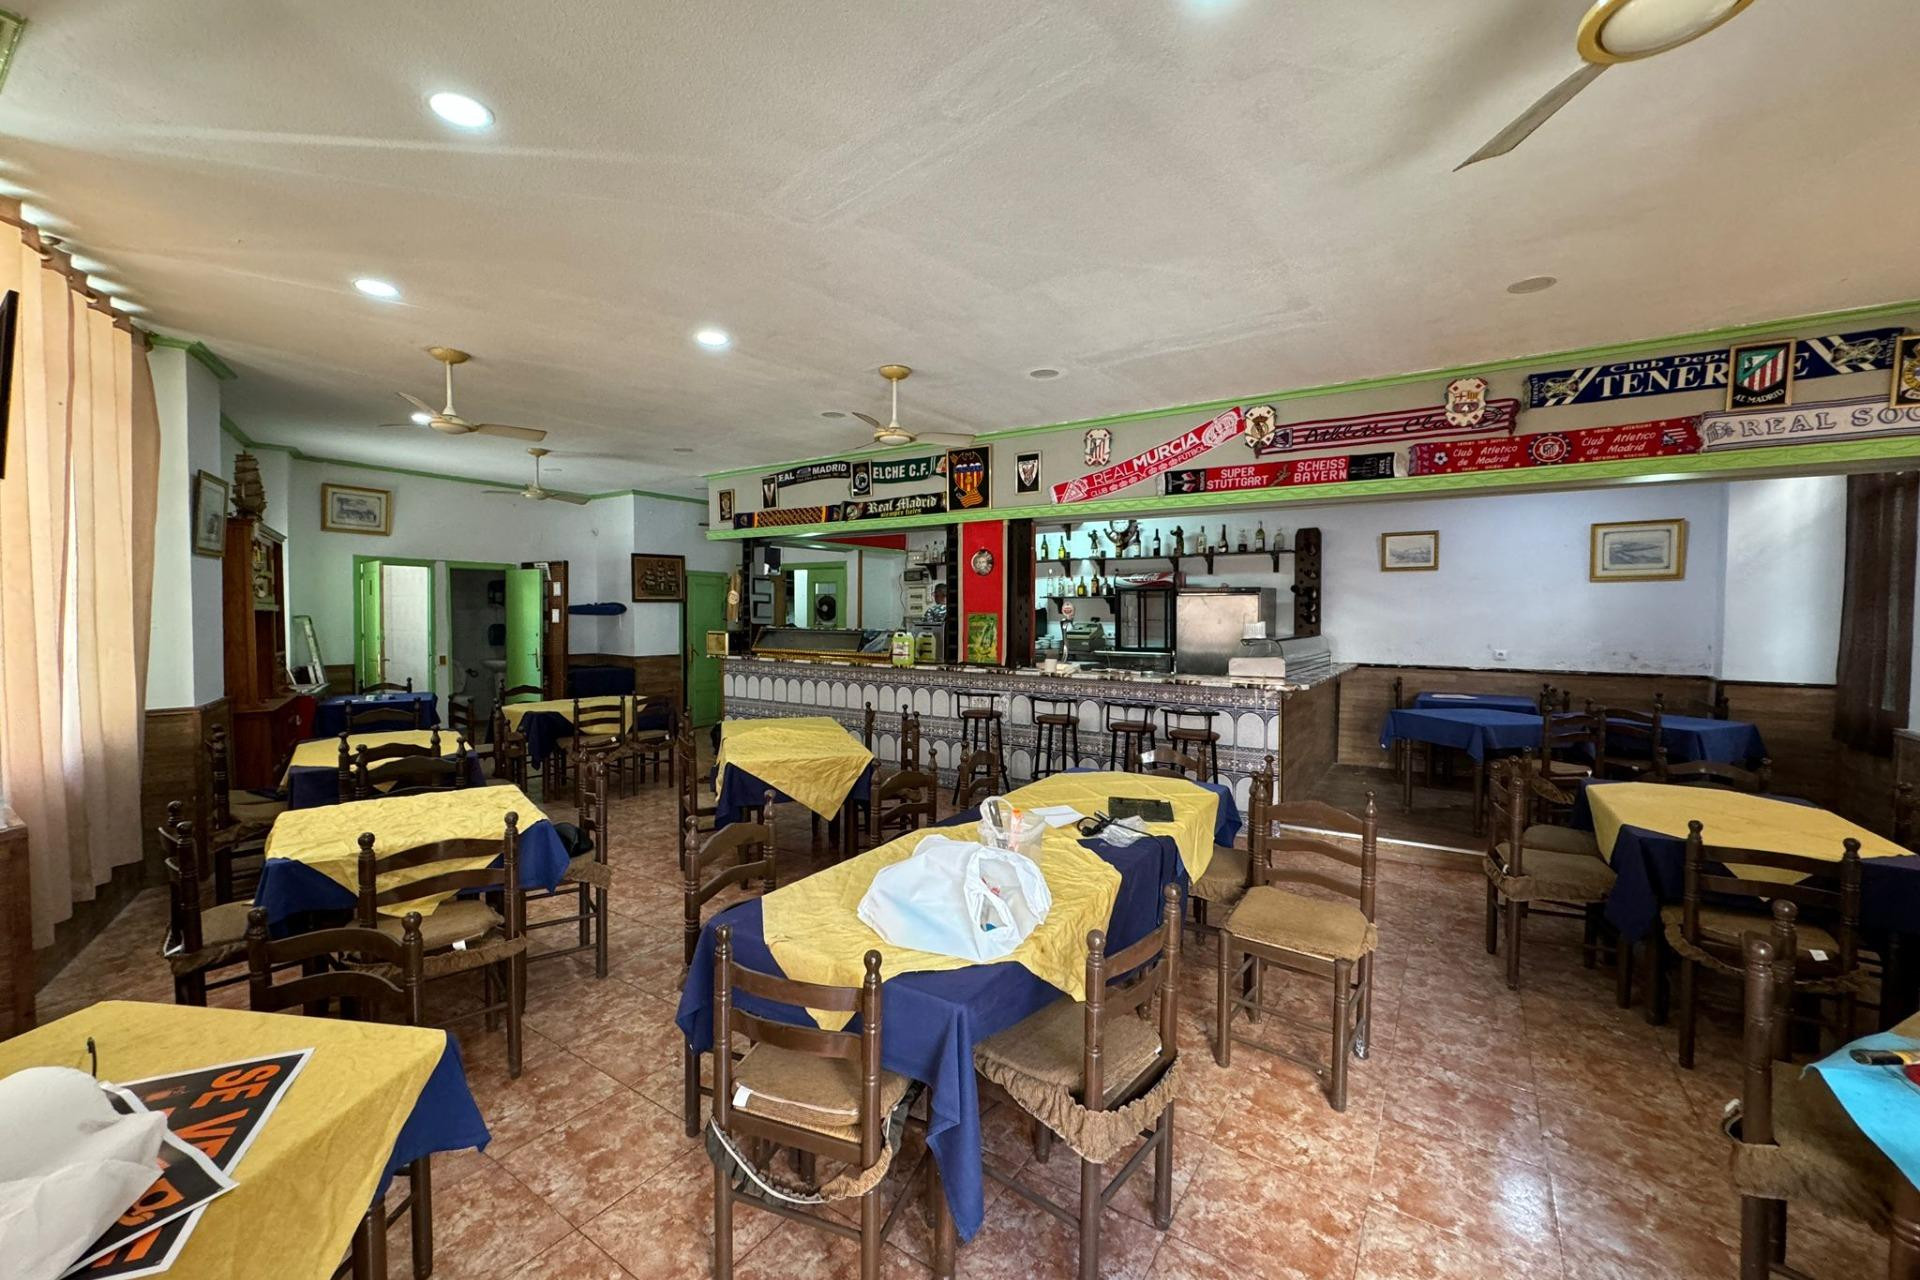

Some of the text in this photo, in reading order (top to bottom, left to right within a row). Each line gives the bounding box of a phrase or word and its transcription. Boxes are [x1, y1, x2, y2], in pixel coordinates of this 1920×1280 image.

[1609, 356, 1664, 374] Club
[1747, 388, 1785, 404] MADRID
[1739, 412, 1837, 438] REAL
[1304, 423, 1393, 444] Athletic
[1581, 435, 1605, 446] Club
[1453, 447, 1473, 457] Club
[1586, 441, 1647, 455] de Madrid
[1092, 463, 1134, 487] REAL
[1132, 432, 1201, 472] MURCIA
[1297, 458, 1347, 472] SCHEISS
[1457, 455, 1511, 467] de Madrid
[777, 472, 795, 482] EAL
[812, 463, 847, 475] MADRID
[872, 462, 929, 480] ELCHE C.F.
[1220, 466, 1256, 479] SUPER
[1293, 469, 1347, 483] BAYERN
[1206, 475, 1269, 490] STUTTGART
[866, 495, 938, 514] Real Madrid
